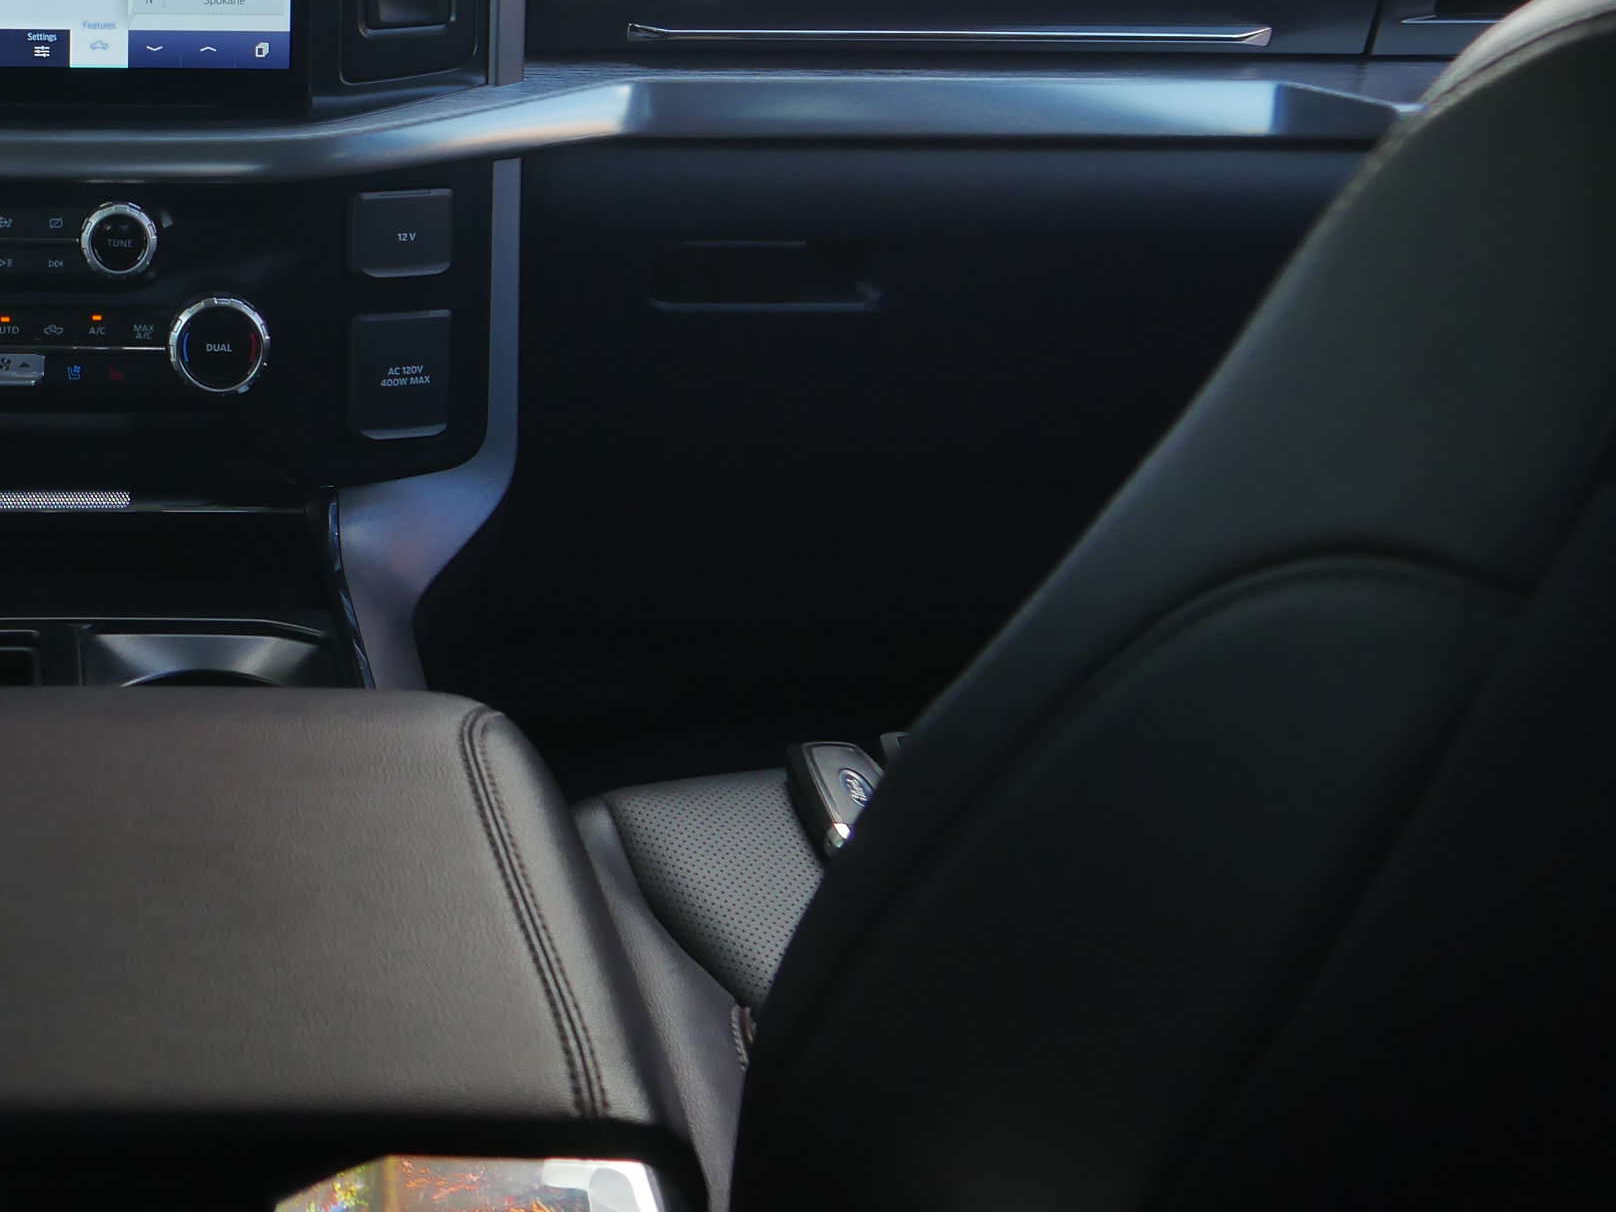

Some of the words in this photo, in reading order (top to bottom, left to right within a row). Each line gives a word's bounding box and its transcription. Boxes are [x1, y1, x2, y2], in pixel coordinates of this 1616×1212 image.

[82, 21, 116, 30] Features
[27, 32, 58, 43] Settings
[397, 232, 408, 242] 12
[409, 232, 416, 241] V
[107, 238, 133, 247] TUNE
[88, 326, 107, 335] A/C
[133, 324, 154, 332] MAX
[135, 332, 152, 340] A/C
[206, 343, 232, 352] DUAL
[388, 367, 400, 376] AC
[402, 365, 424, 375] 120V
[380, 378, 408, 387] 400W
[410, 375, 430, 385] MAX
